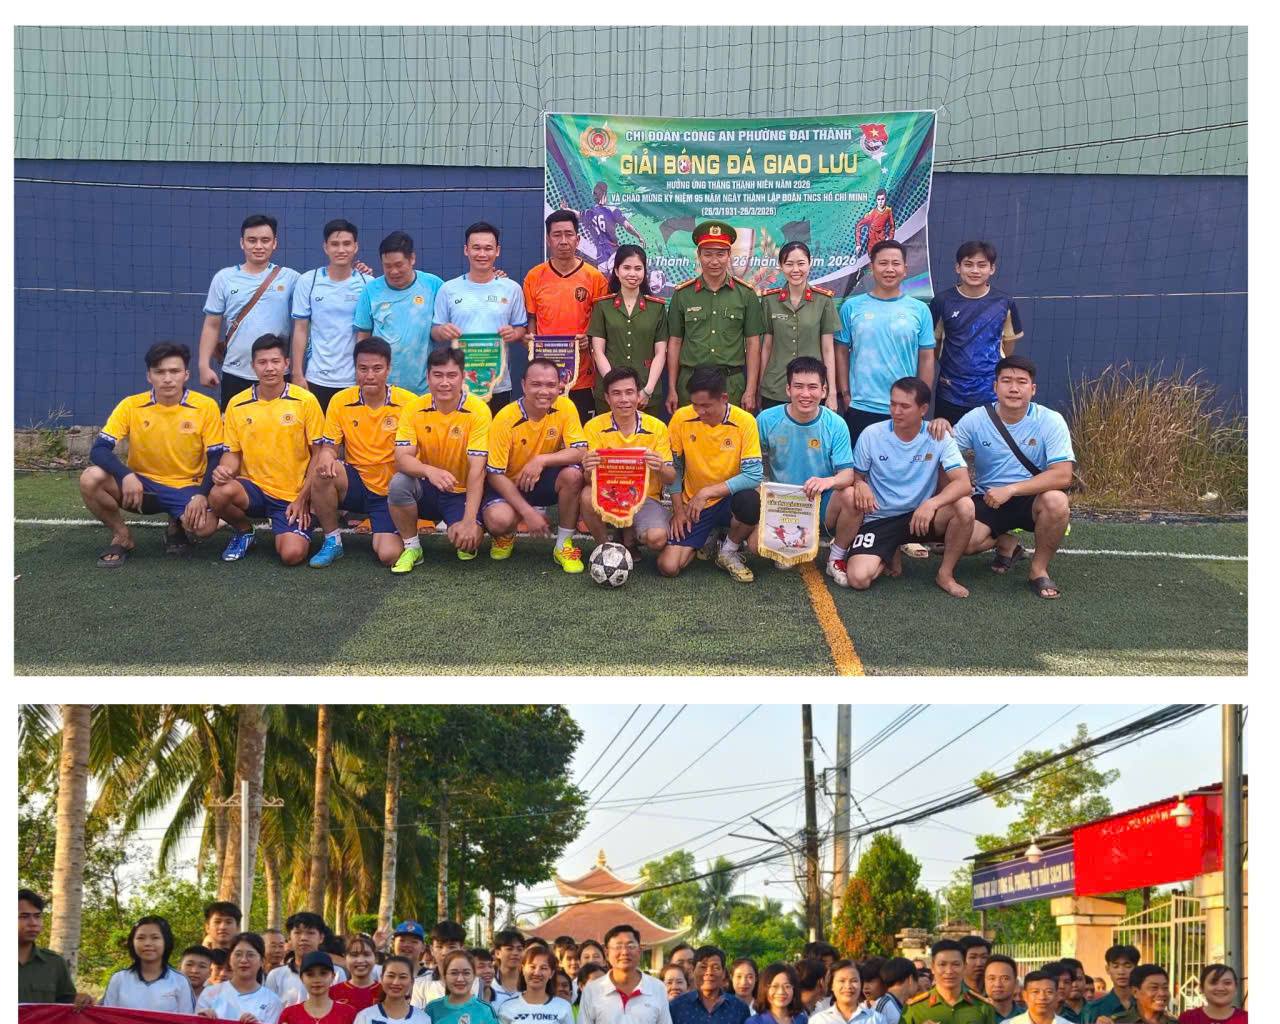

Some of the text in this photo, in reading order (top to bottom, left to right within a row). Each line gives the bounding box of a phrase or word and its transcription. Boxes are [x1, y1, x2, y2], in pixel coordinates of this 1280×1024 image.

[625, 131, 645, 141] CHI
[718, 131, 734, 141] AN
[620, 147, 858, 175] GIẢI BÓNG ĐÁ GIAO LƯU
[793, 181, 811, 189] 2026
[848, 193, 868, 203] MINH
[655, 255, 689, 267] Thành
[733, 255, 747, 267] 26
[828, 255, 857, 267] 2026
[531, 1012, 559, 1021] YONEX
